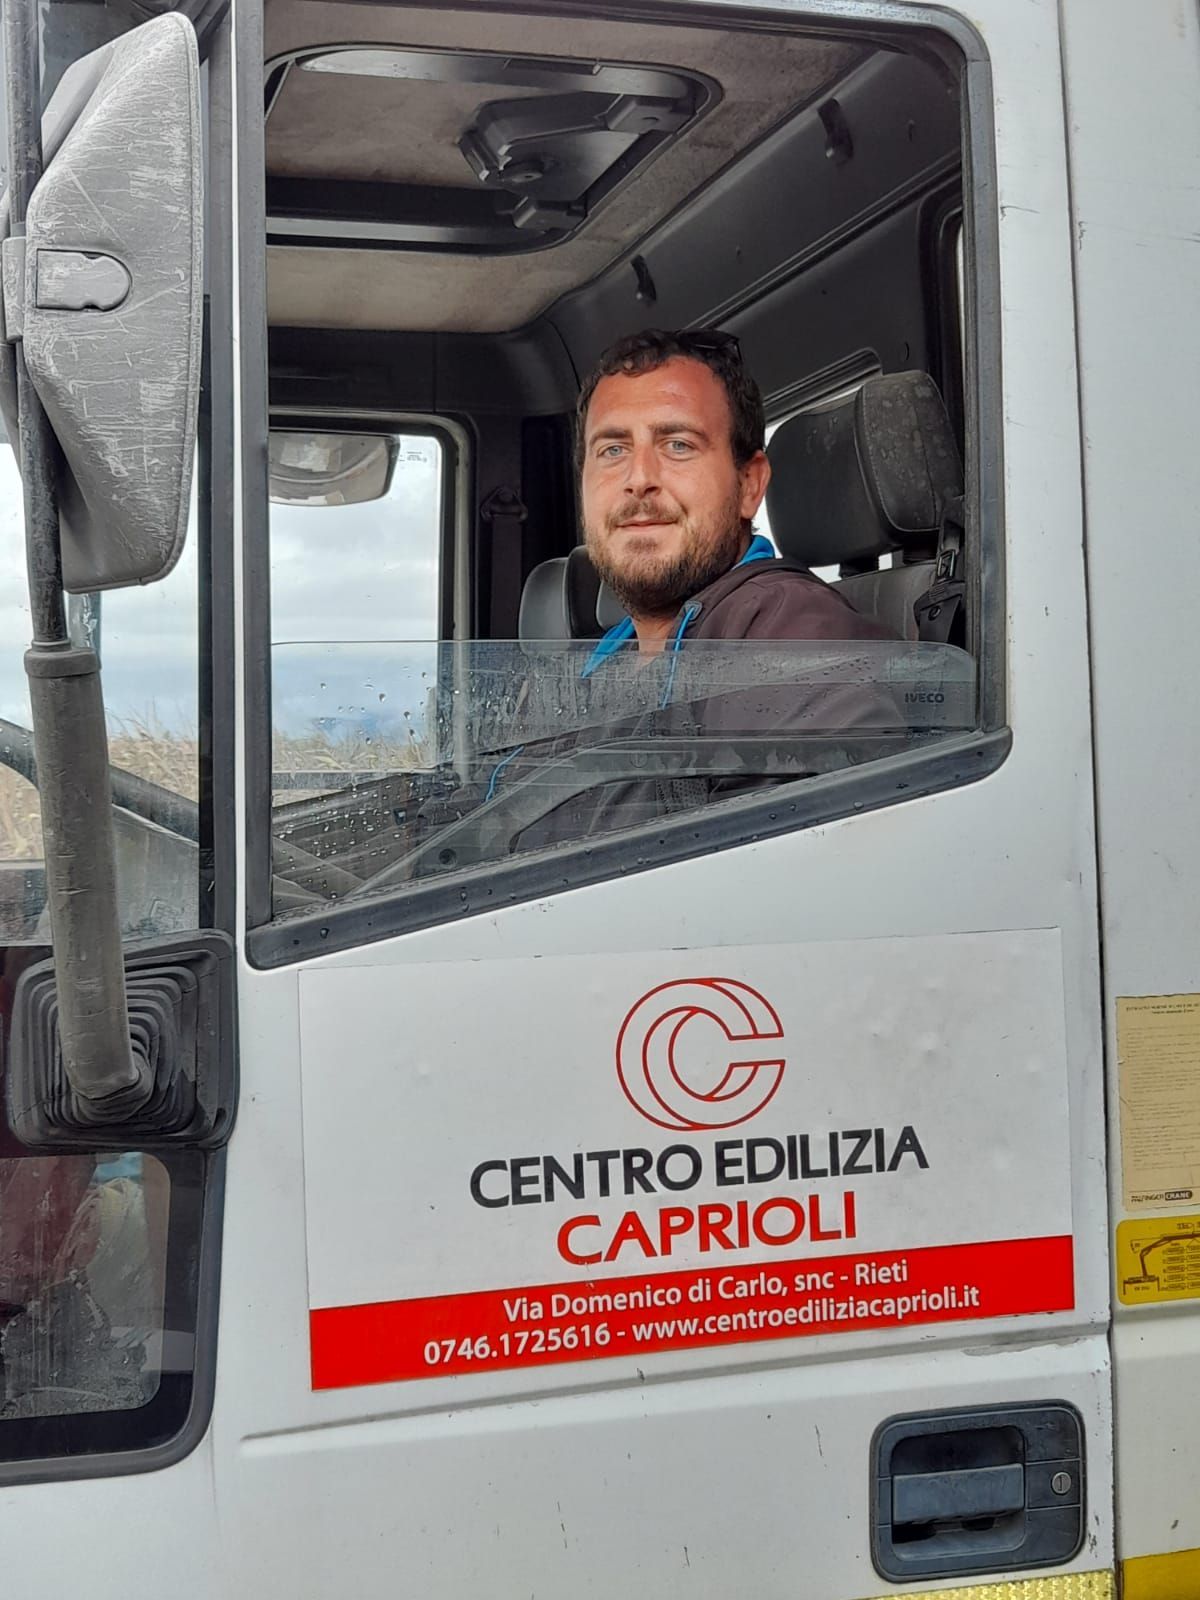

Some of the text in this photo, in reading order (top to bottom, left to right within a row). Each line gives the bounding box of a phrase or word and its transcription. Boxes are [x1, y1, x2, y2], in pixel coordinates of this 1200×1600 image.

[904, 692, 945, 704] IVECO
[470, 1125, 929, 1209] CENTRO EDILIZIA
[556, 1190, 857, 1267] CAPRIOLI
[424, 1322, 611, 1365] 0746.1725616
[632, 1285, 980, 1341] www.centroediliziacaprioli.it
[503, 1297, 543, 1322] Via
[551, 1283, 682, 1318] Domenico
[688, 1278, 711, 1303] di
[718, 1271, 789, 1300] Carlo,
[794, 1273, 834, 1292] snc
[855, 1260, 908, 1286] Rieti
